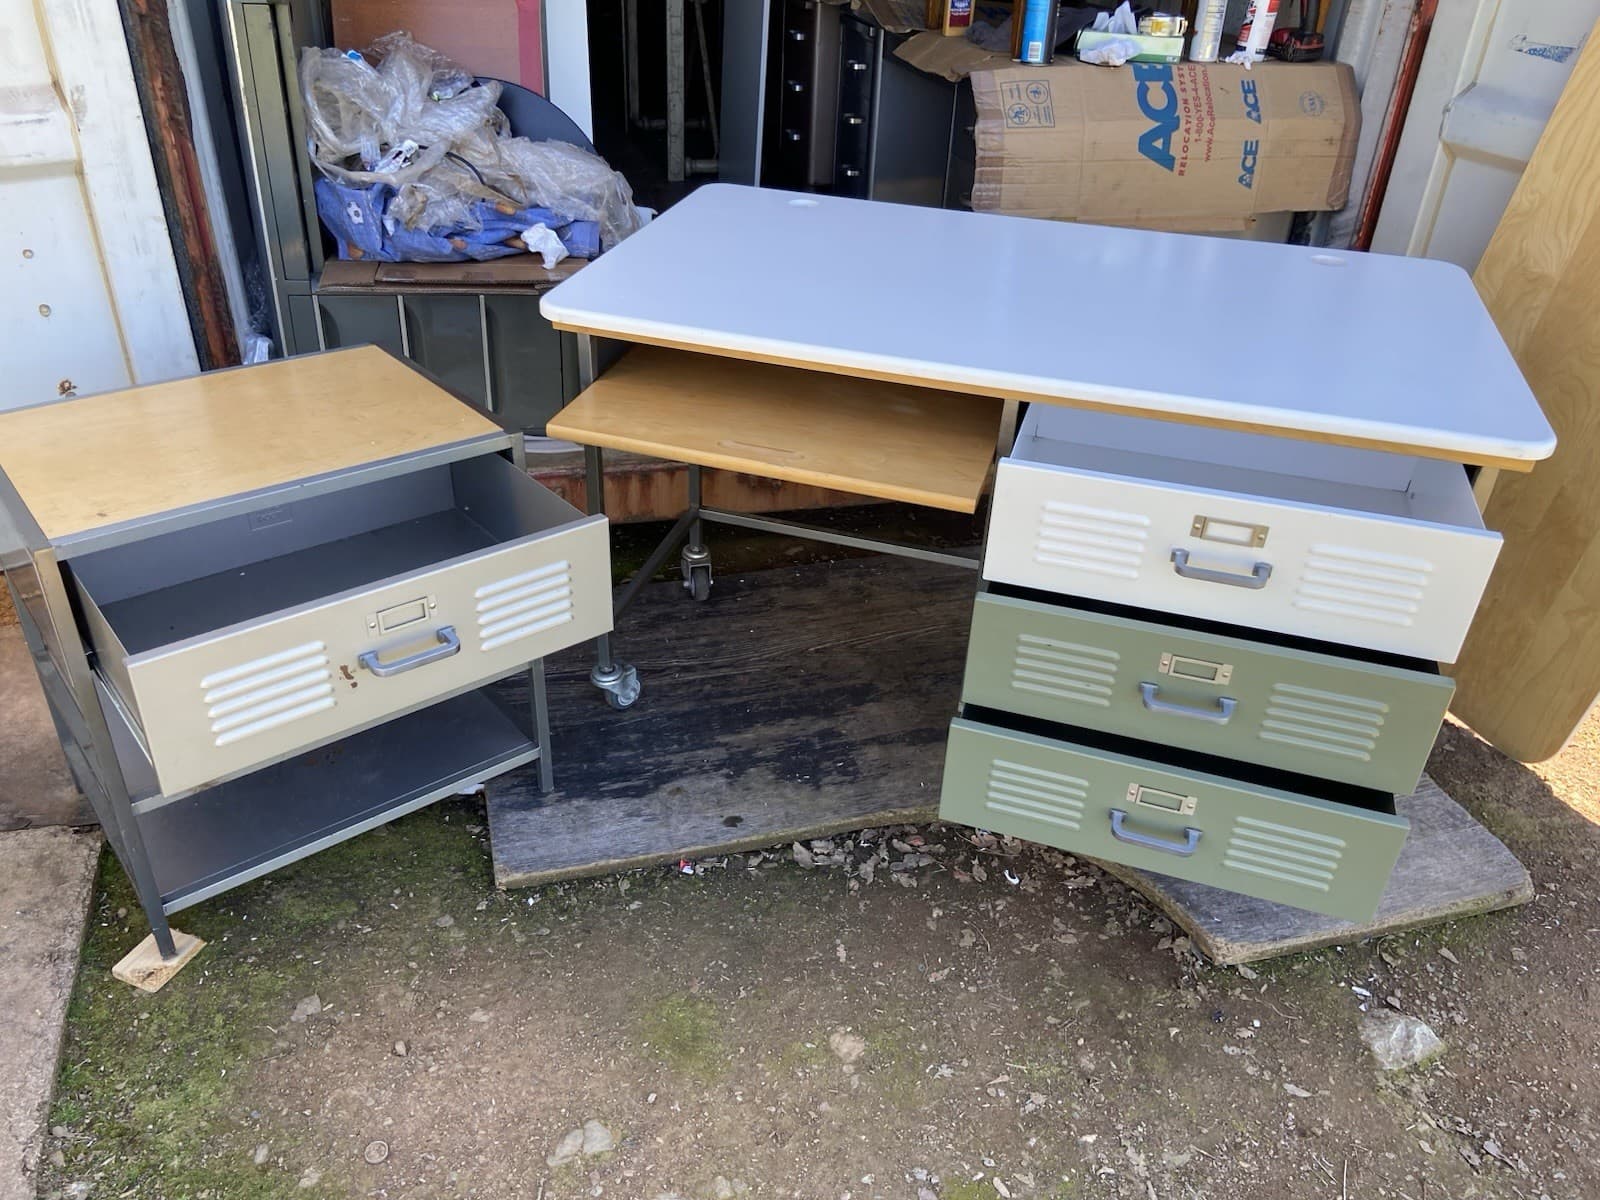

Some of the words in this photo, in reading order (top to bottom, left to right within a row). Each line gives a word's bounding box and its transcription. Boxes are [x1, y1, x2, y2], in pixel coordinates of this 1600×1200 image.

[1241, 80, 1262, 124] ACE
[1178, 98, 1192, 176] RELOCATION
[1238, 140, 1259, 189] ACE
